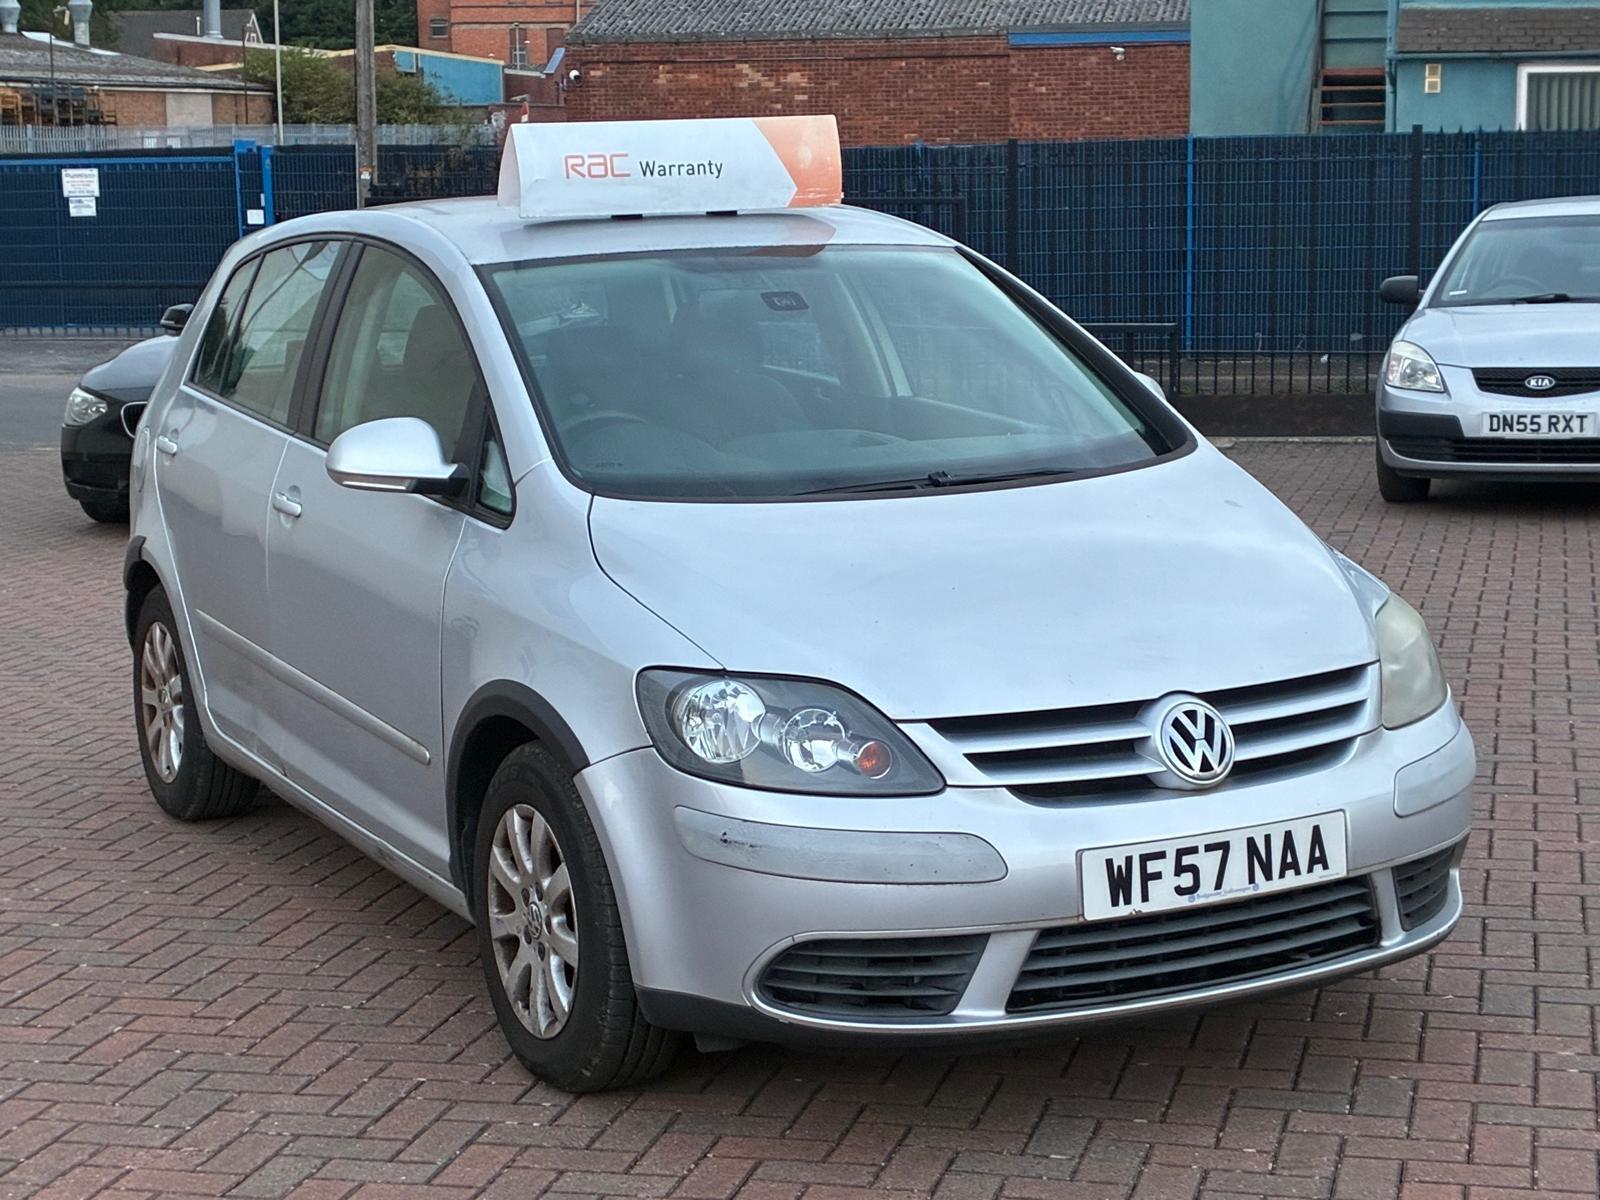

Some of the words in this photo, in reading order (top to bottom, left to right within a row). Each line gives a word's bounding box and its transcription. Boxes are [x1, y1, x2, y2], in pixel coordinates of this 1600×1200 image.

[639, 160, 723, 179] Warranty
[1529, 378, 1551, 387] KIA
[1489, 414, 1541, 433] DN55
[1548, 414, 1588, 433] RXT
[1166, 705, 1230, 777] VW
[1105, 840, 1231, 907] WF57
[1246, 824, 1329, 885] NAA
